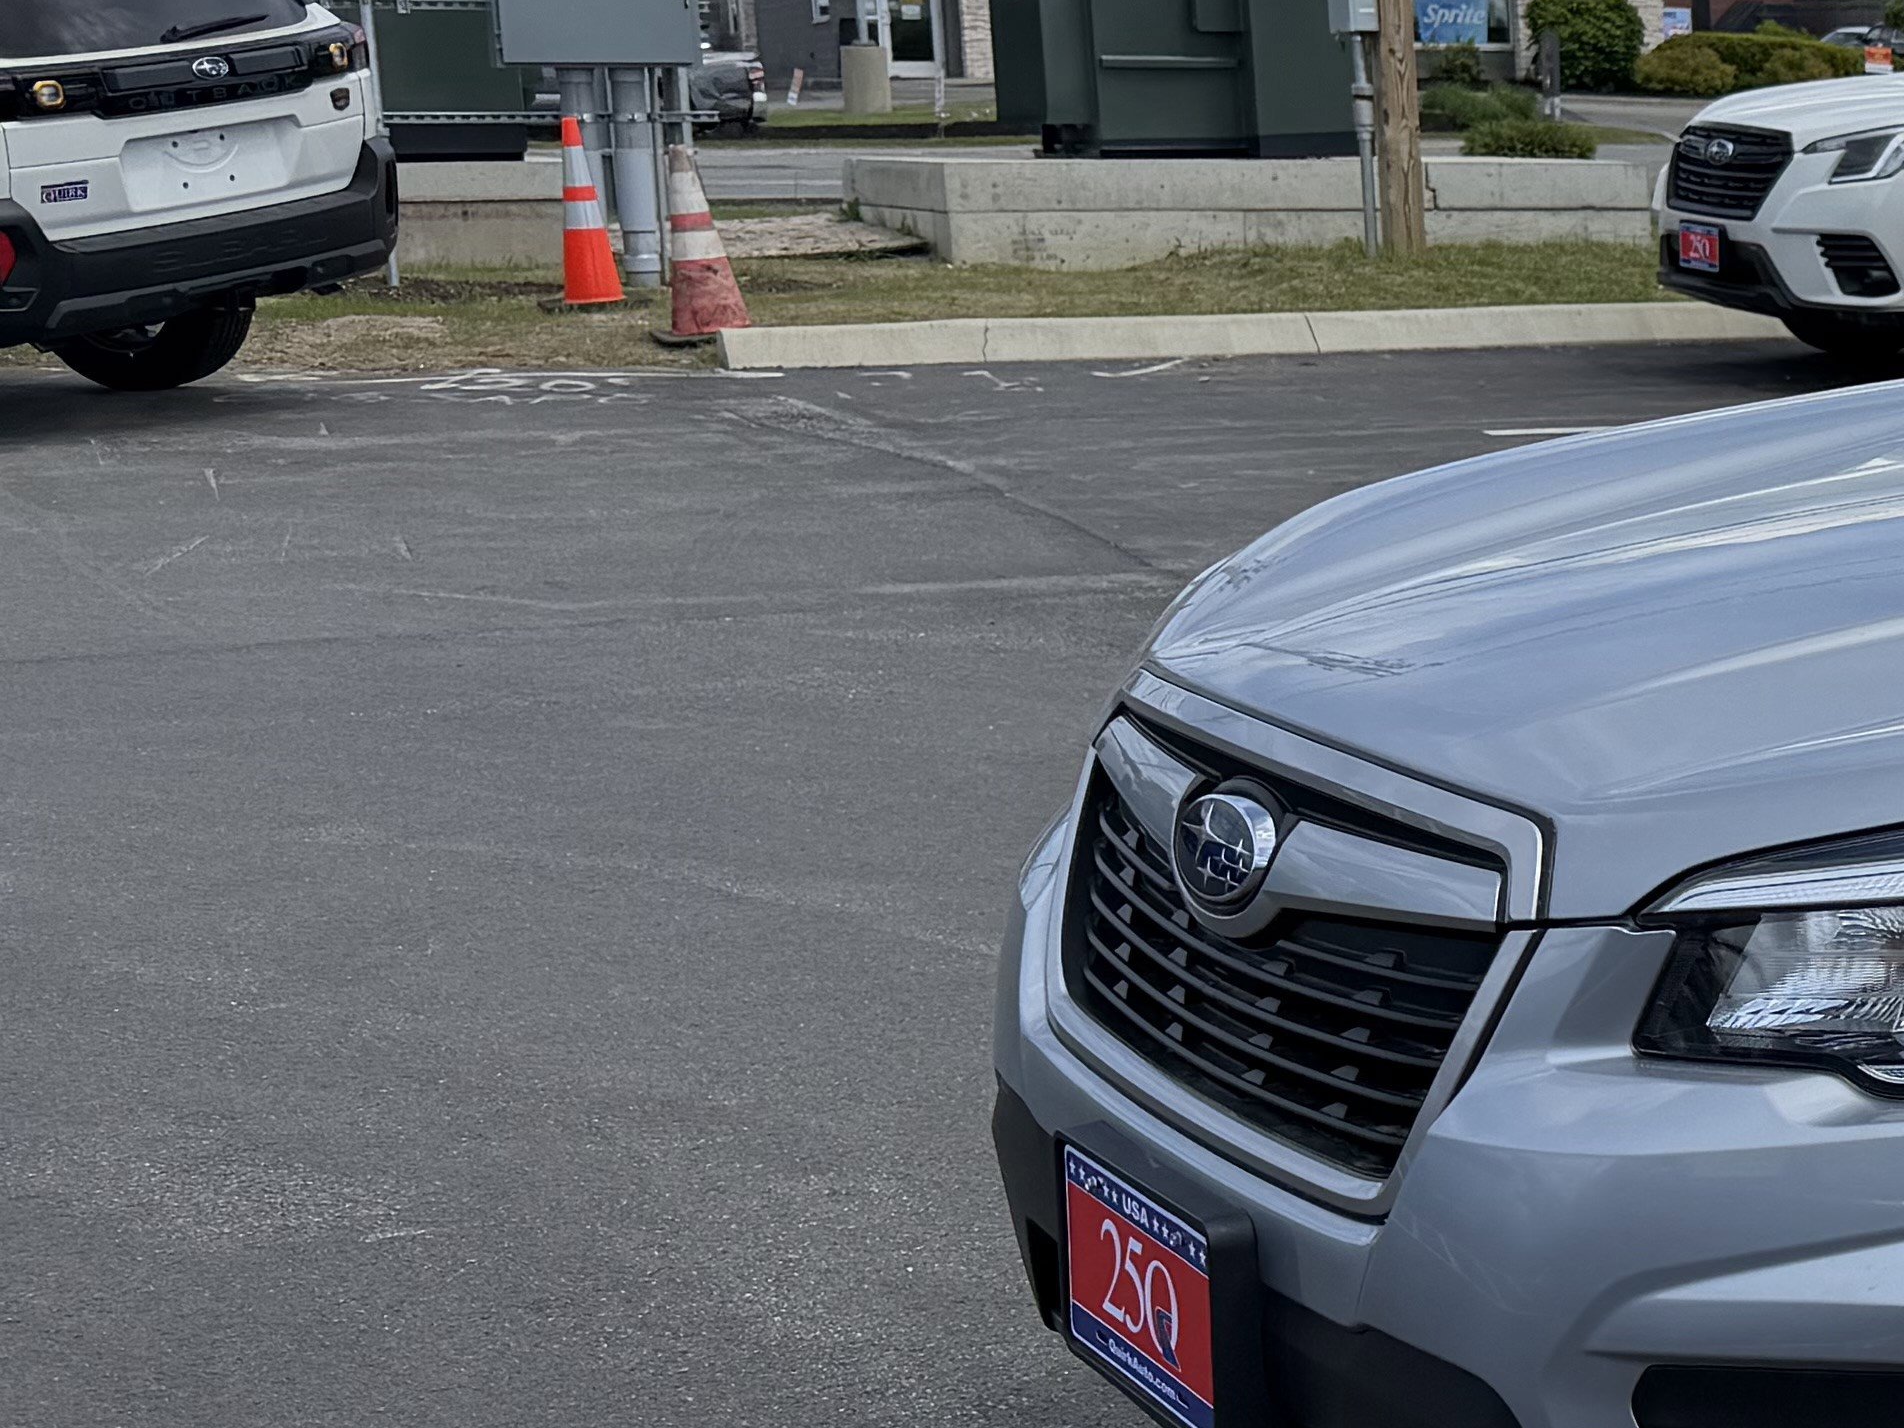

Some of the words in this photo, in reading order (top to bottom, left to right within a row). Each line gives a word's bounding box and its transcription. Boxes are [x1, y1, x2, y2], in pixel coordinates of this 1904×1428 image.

[1423, 2, 1486, 29] Sprite
[1122, 1193, 1150, 1227] USA
[1107, 1337, 1177, 1401] QuirkAuto.com
